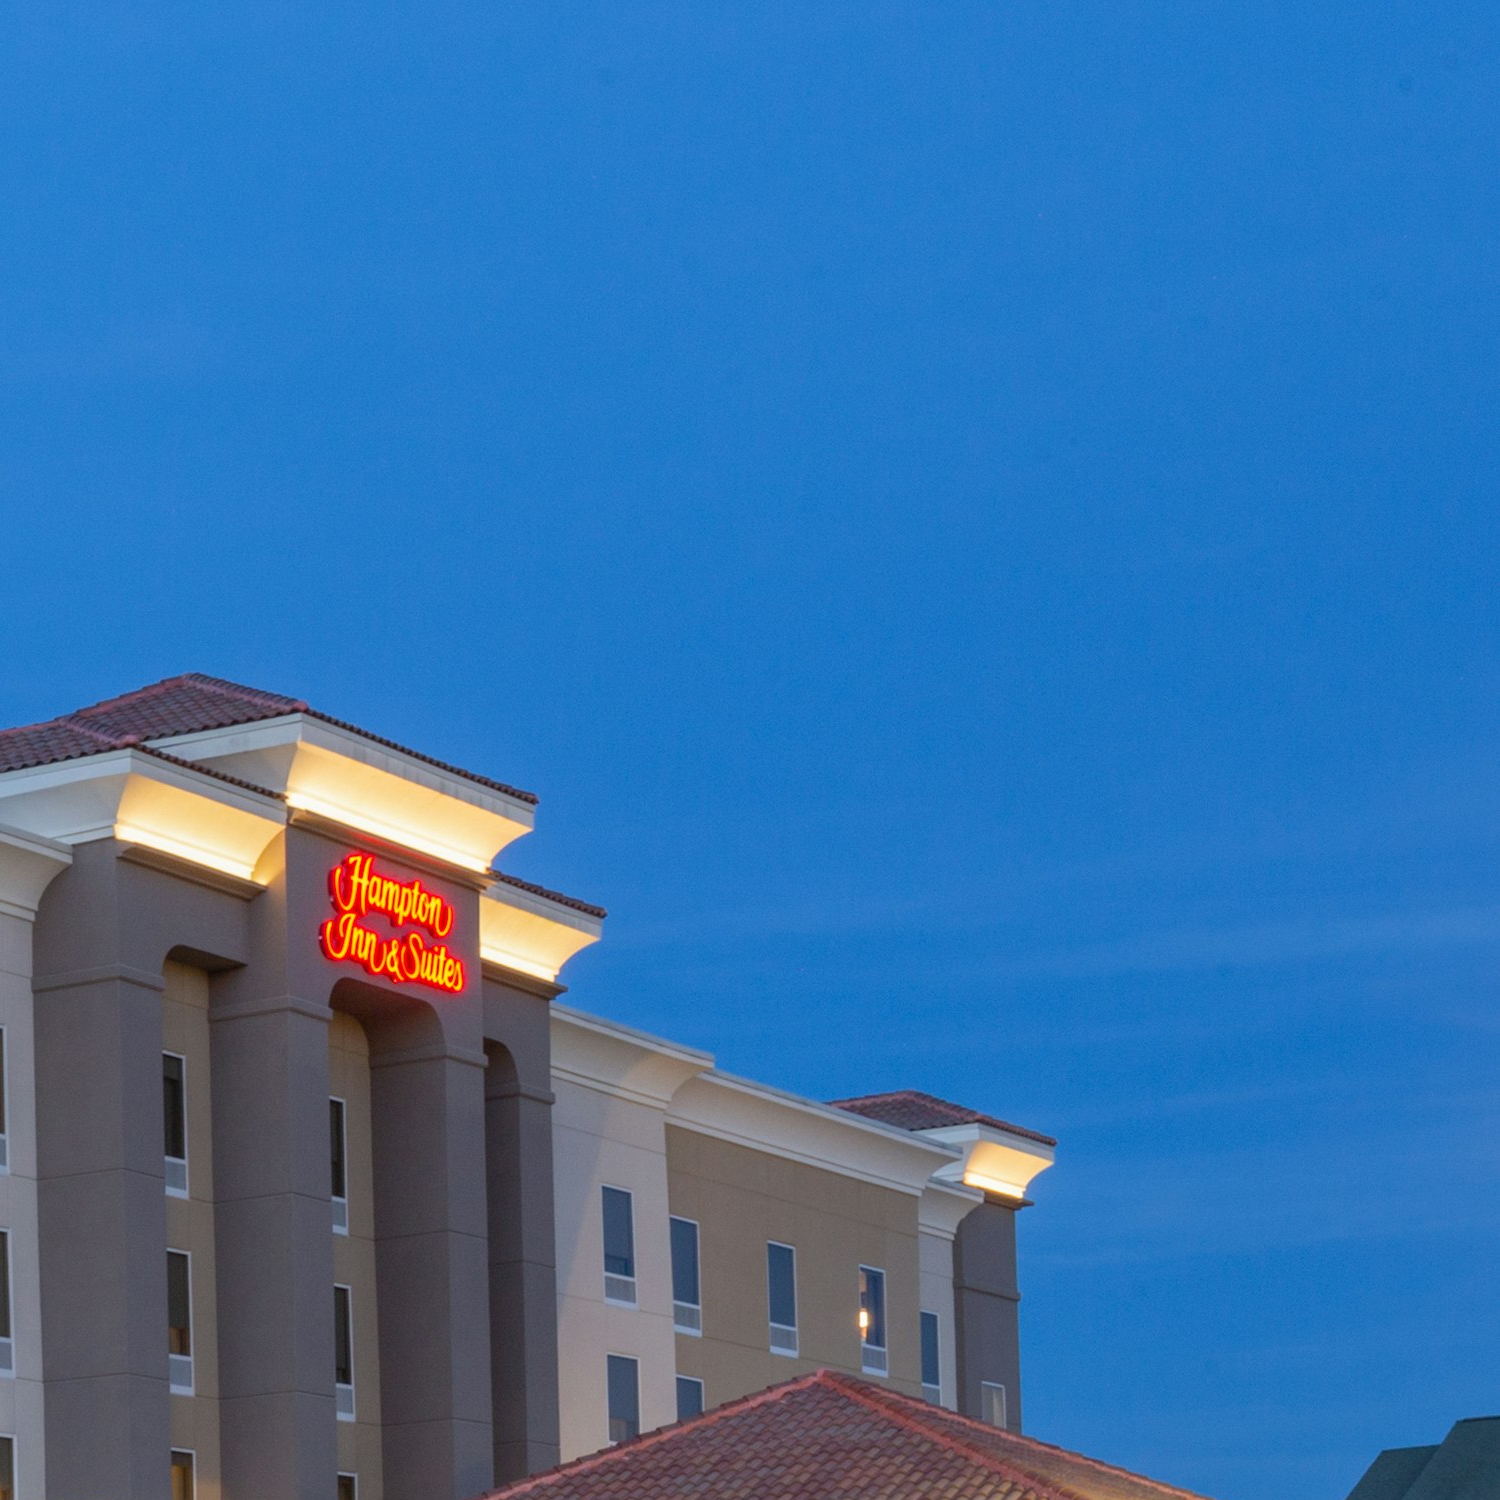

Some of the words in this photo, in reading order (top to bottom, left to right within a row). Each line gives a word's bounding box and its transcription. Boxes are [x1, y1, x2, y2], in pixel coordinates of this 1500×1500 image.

[331, 854, 453, 937] Hampton
[323, 913, 387, 973] Inn
[386, 939, 405, 981] &
[401, 933, 464, 992] Suites
